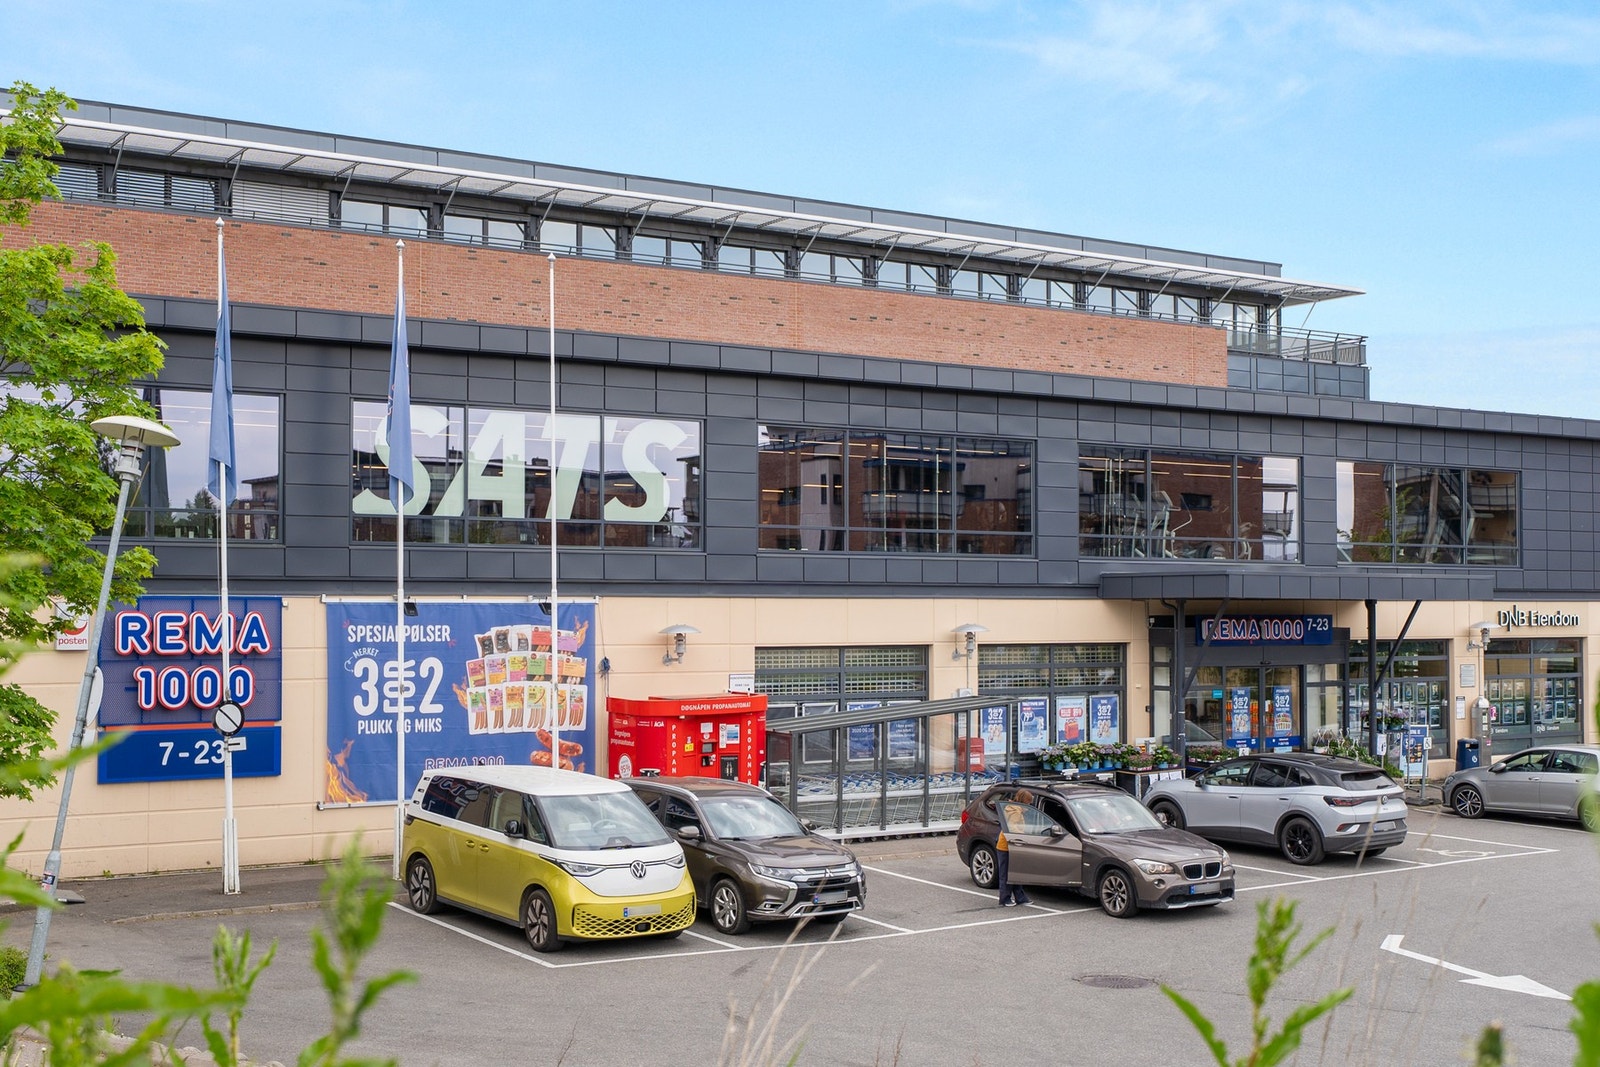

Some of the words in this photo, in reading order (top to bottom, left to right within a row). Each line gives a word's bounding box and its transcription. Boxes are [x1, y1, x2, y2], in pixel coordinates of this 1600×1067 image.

[352, 404, 688, 522] SATS
[1202, 619, 1260, 640] REMA
[1260, 619, 1304, 640] 1000
[1306, 618, 1329, 631] 7-23
[1498, 605, 1526, 631] DNB
[1528, 610, 1580, 627] Eiendom
[58, 637, 87, 646] posten
[115, 611, 272, 655] REMA
[352, 647, 379, 658] MERKET
[133, 664, 256, 711] 1000
[353, 657, 379, 716] 3
[383, 659, 416, 713] FOR
[419, 657, 444, 714] 2
[358, 719, 393, 734] PLUKK
[396, 718, 411, 733] G
[415, 717, 442, 733] MIKS
[425, 756, 469, 770] REMA
[472, 755, 505, 766] 1000
